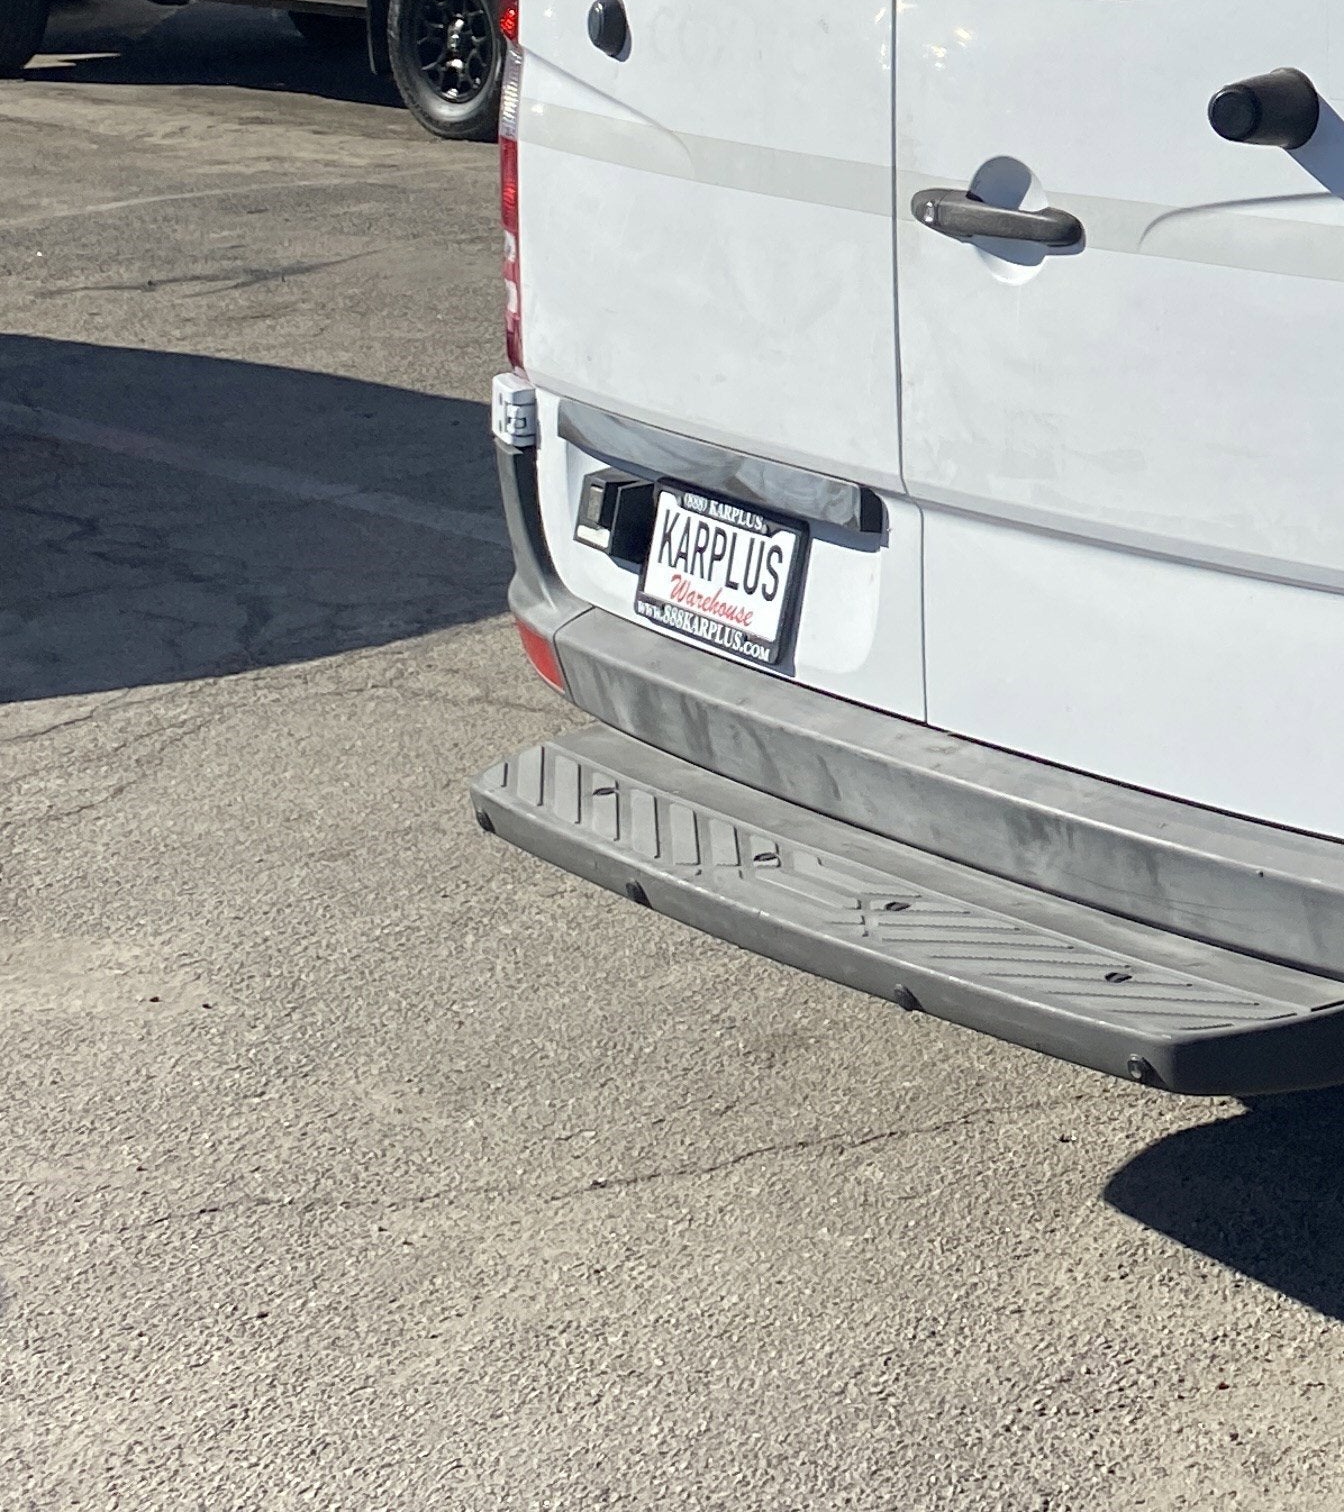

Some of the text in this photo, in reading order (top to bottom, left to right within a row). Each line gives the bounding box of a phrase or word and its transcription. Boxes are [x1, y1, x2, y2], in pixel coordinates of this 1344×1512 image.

[683, 492, 763, 530] (888) KARPLUS
[657, 508, 784, 602] KARPLUS
[669, 573, 755, 628] Warehouse
